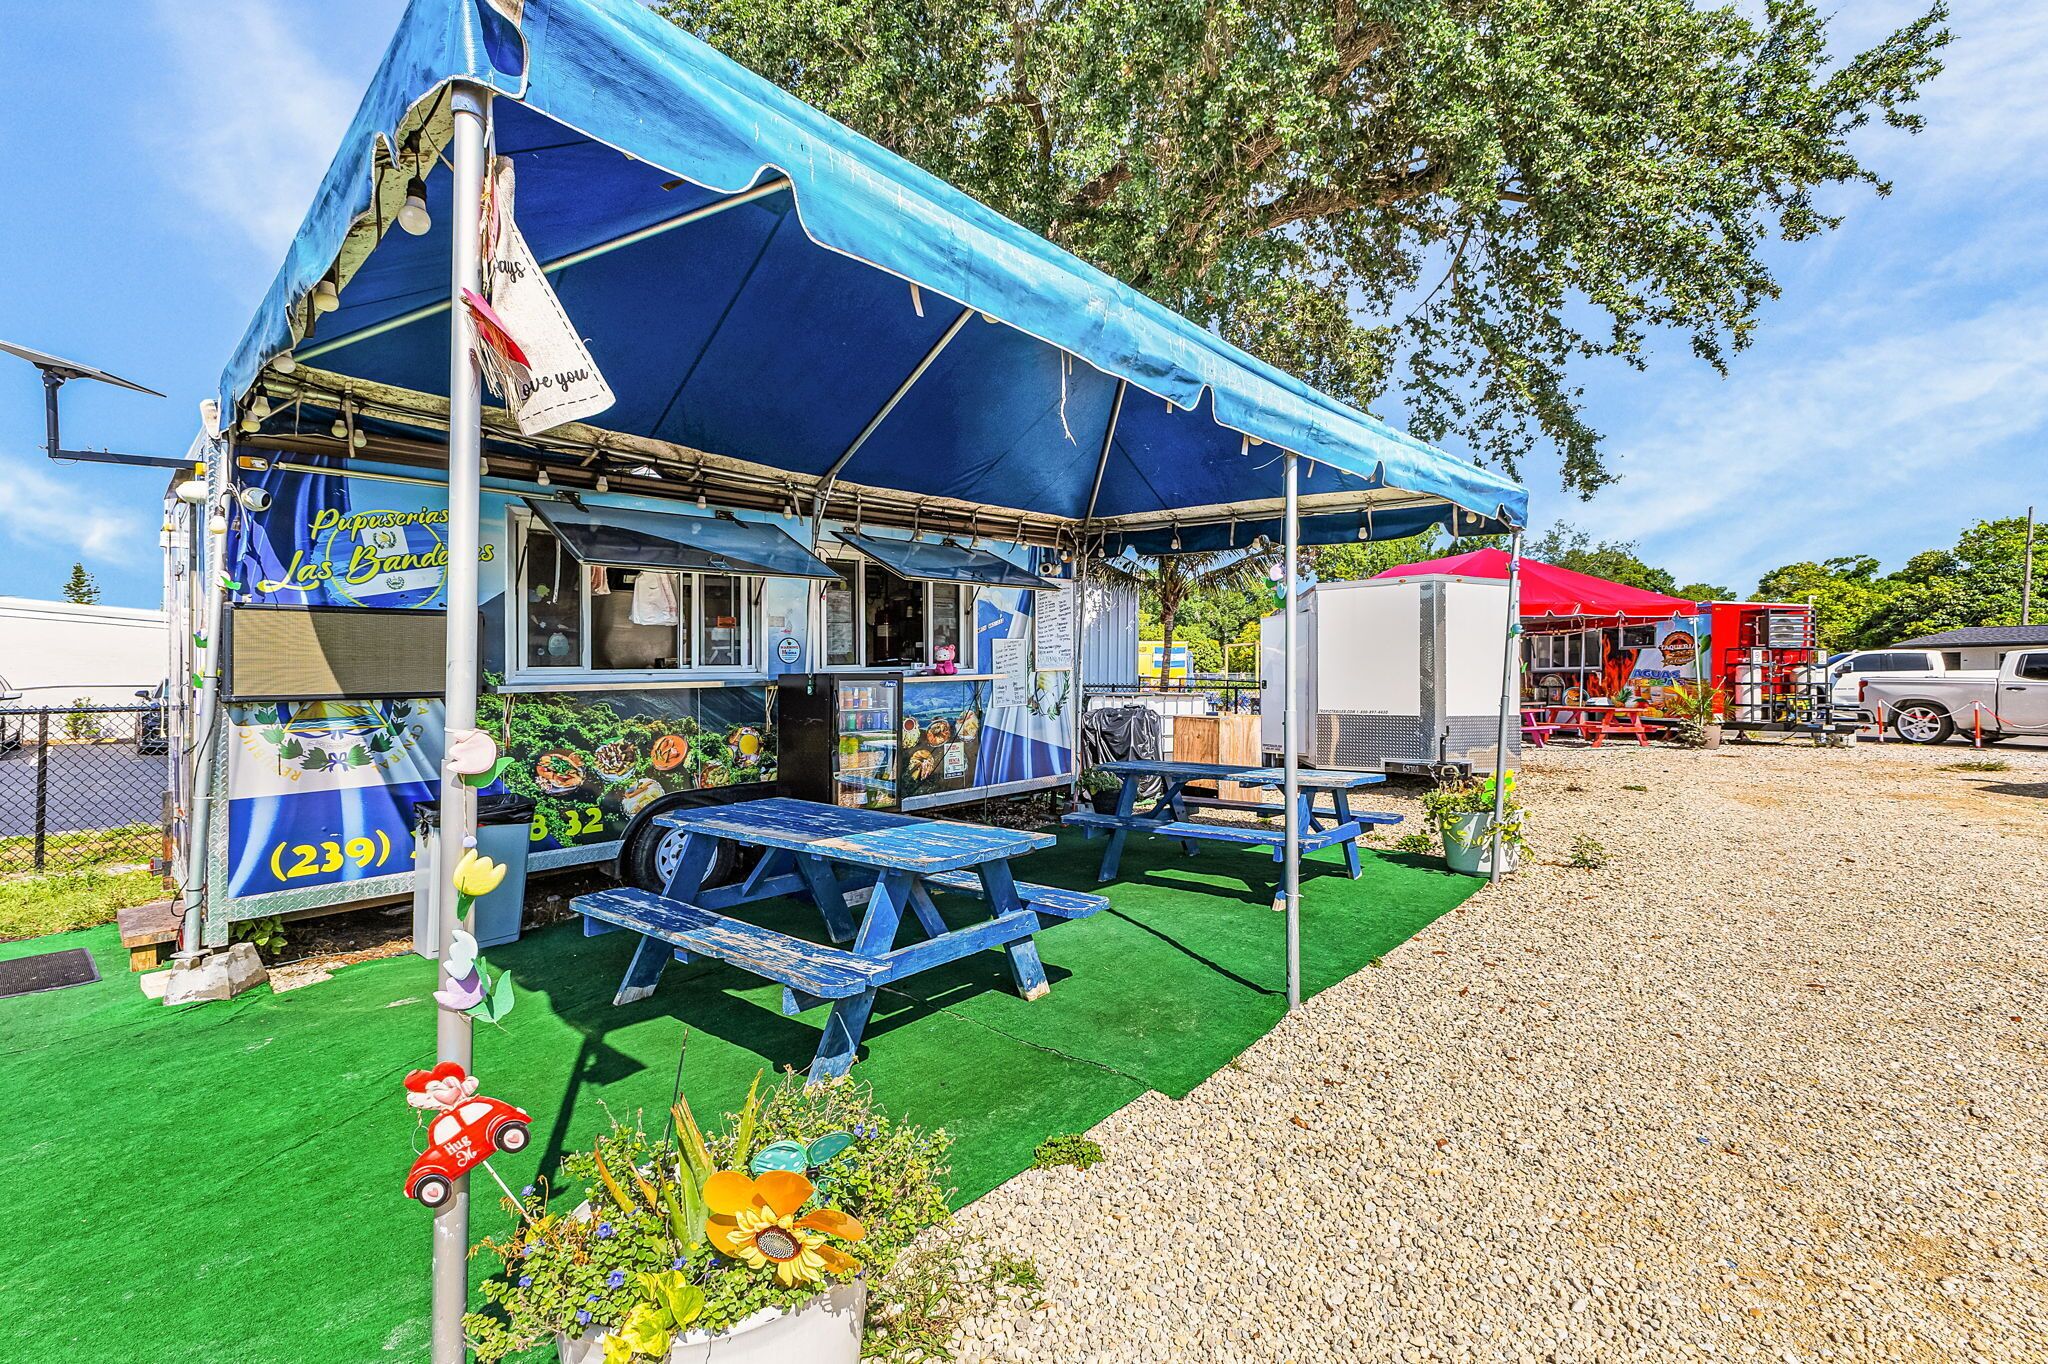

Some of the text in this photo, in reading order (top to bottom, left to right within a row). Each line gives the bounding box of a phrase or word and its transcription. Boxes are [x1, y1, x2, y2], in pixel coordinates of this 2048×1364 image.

[494, 259, 526, 284] ays
[520, 368, 589, 401] ove you
[309, 507, 449, 542] Pupuserias
[257, 542, 495, 593] Las Bandes
[1633, 669, 1681, 679] AGUAS
[270, 829, 392, 882] (239)
[564, 807, 604, 836] 32
[443, 1135, 472, 1156] Hug
